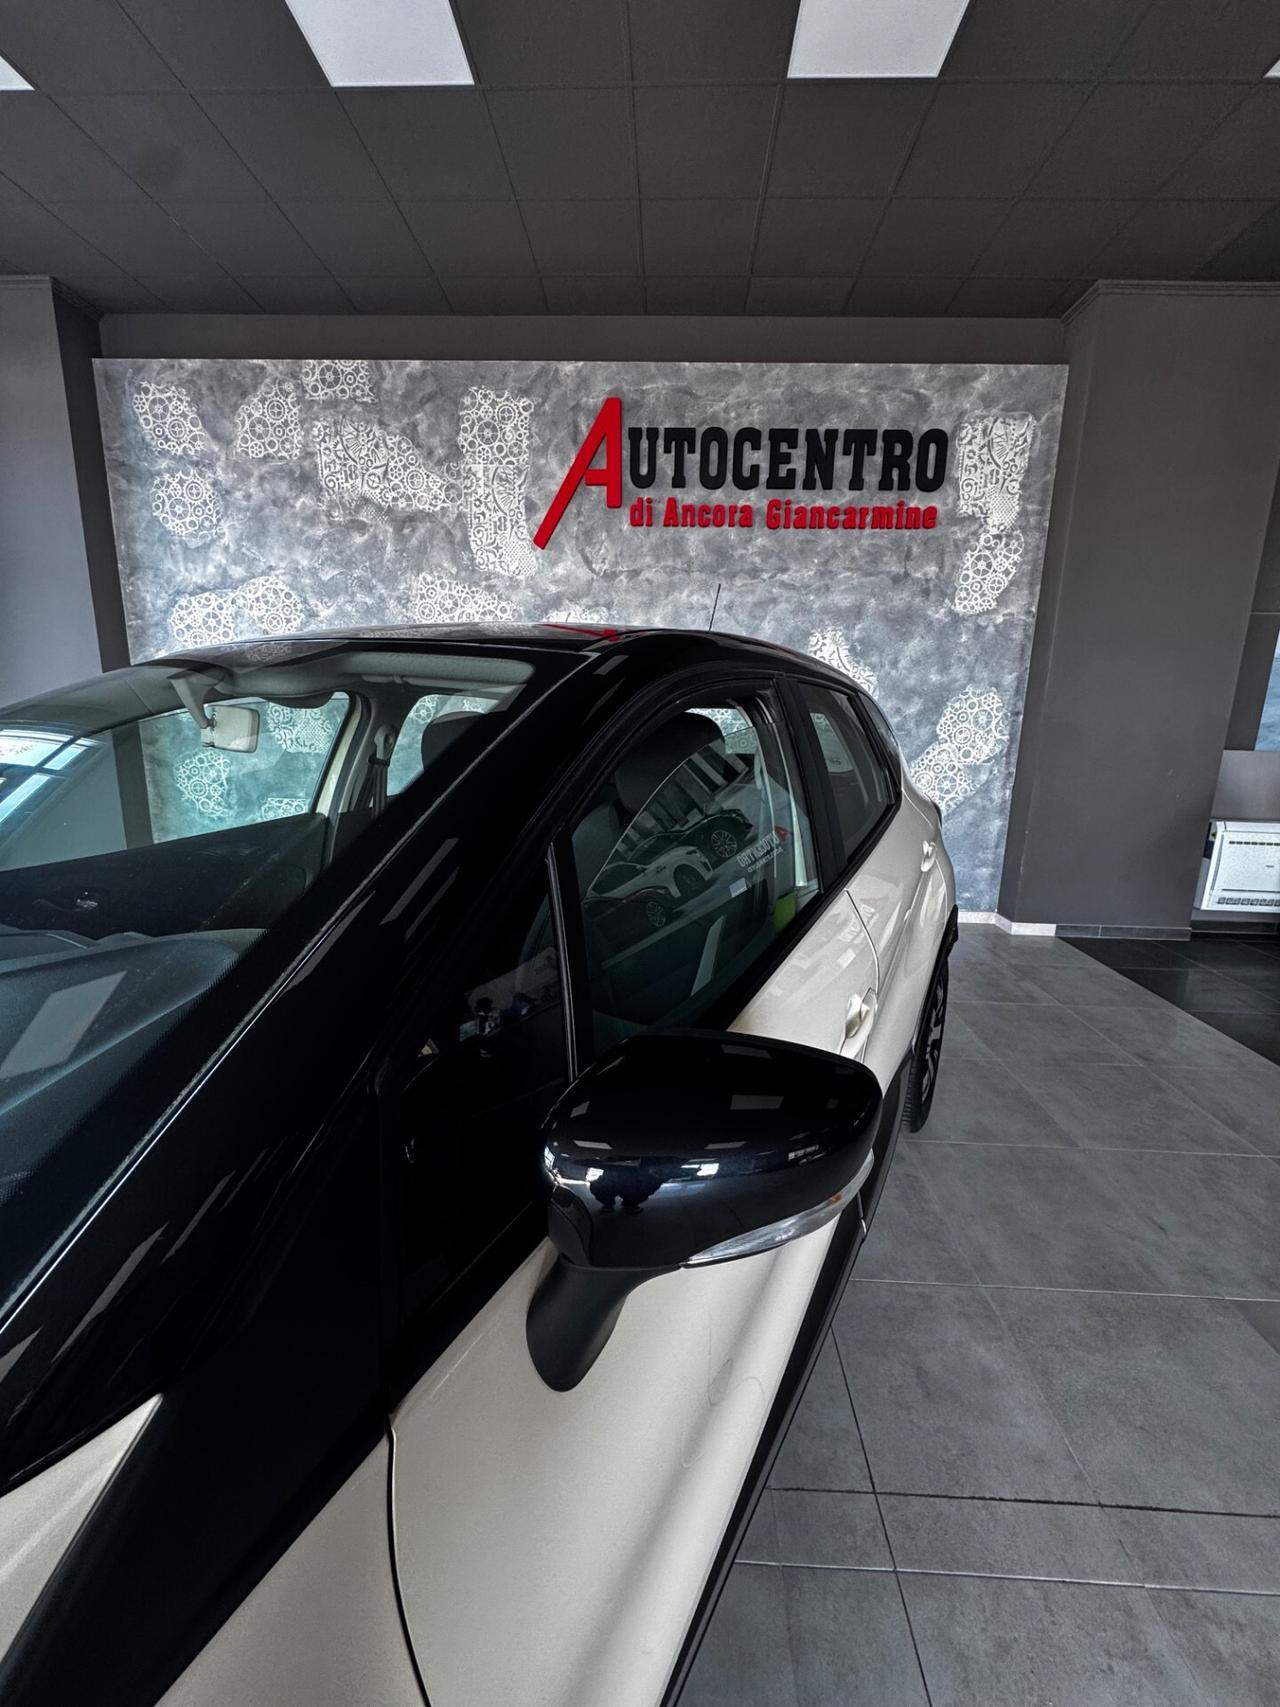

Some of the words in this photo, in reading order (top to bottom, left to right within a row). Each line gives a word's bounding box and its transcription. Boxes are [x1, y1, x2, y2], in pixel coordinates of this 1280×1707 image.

[533, 397, 949, 549] AUTOCENTRO
[629, 498, 653, 527] di
[663, 498, 753, 528] Ancora
[766, 499, 938, 530] Giancarmine
